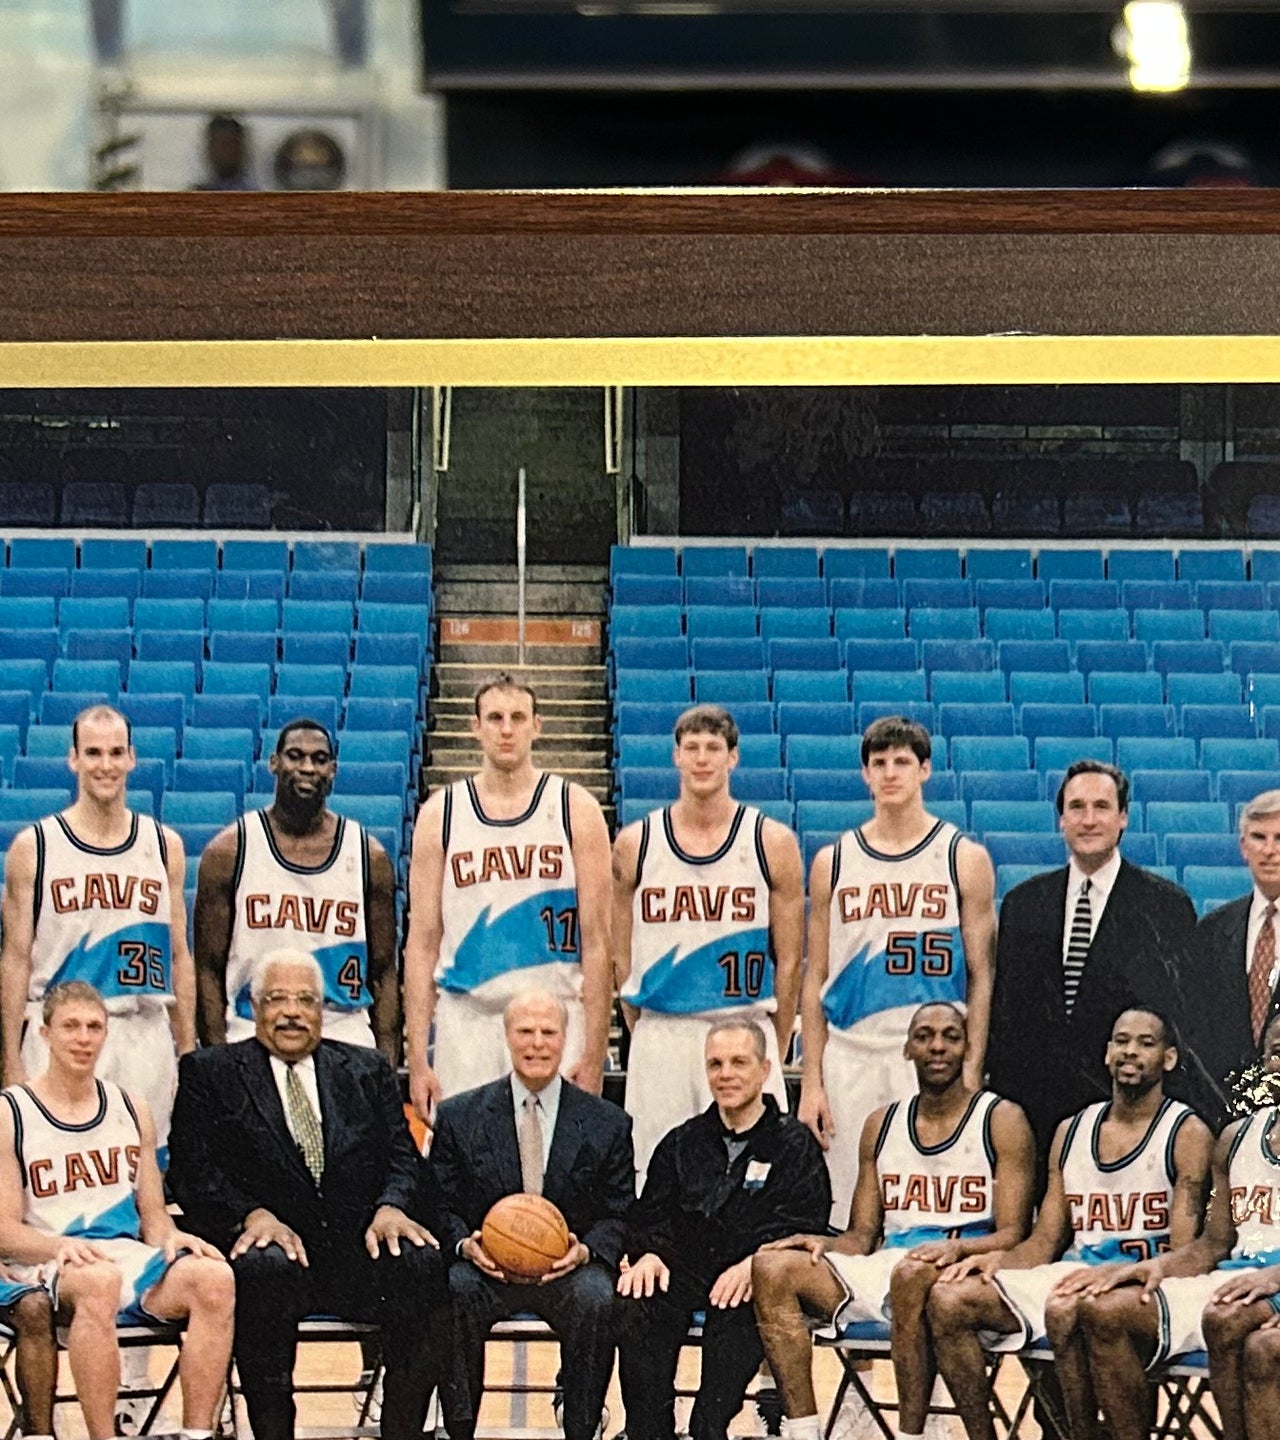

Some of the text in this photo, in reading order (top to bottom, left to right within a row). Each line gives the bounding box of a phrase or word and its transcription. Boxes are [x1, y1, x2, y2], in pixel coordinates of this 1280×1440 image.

[452, 844, 564, 888] CAVS
[51, 873, 162, 915] CAVS
[246, 894, 359, 936] CAVS
[641, 886, 756, 923] CAVS
[838, 883, 949, 924] CAVS
[540, 907, 579, 953] 11
[118, 943, 165, 990] 35
[718, 951, 764, 997] 10
[886, 931, 953, 977] 55
[882, 1174, 986, 1213] CAVS
